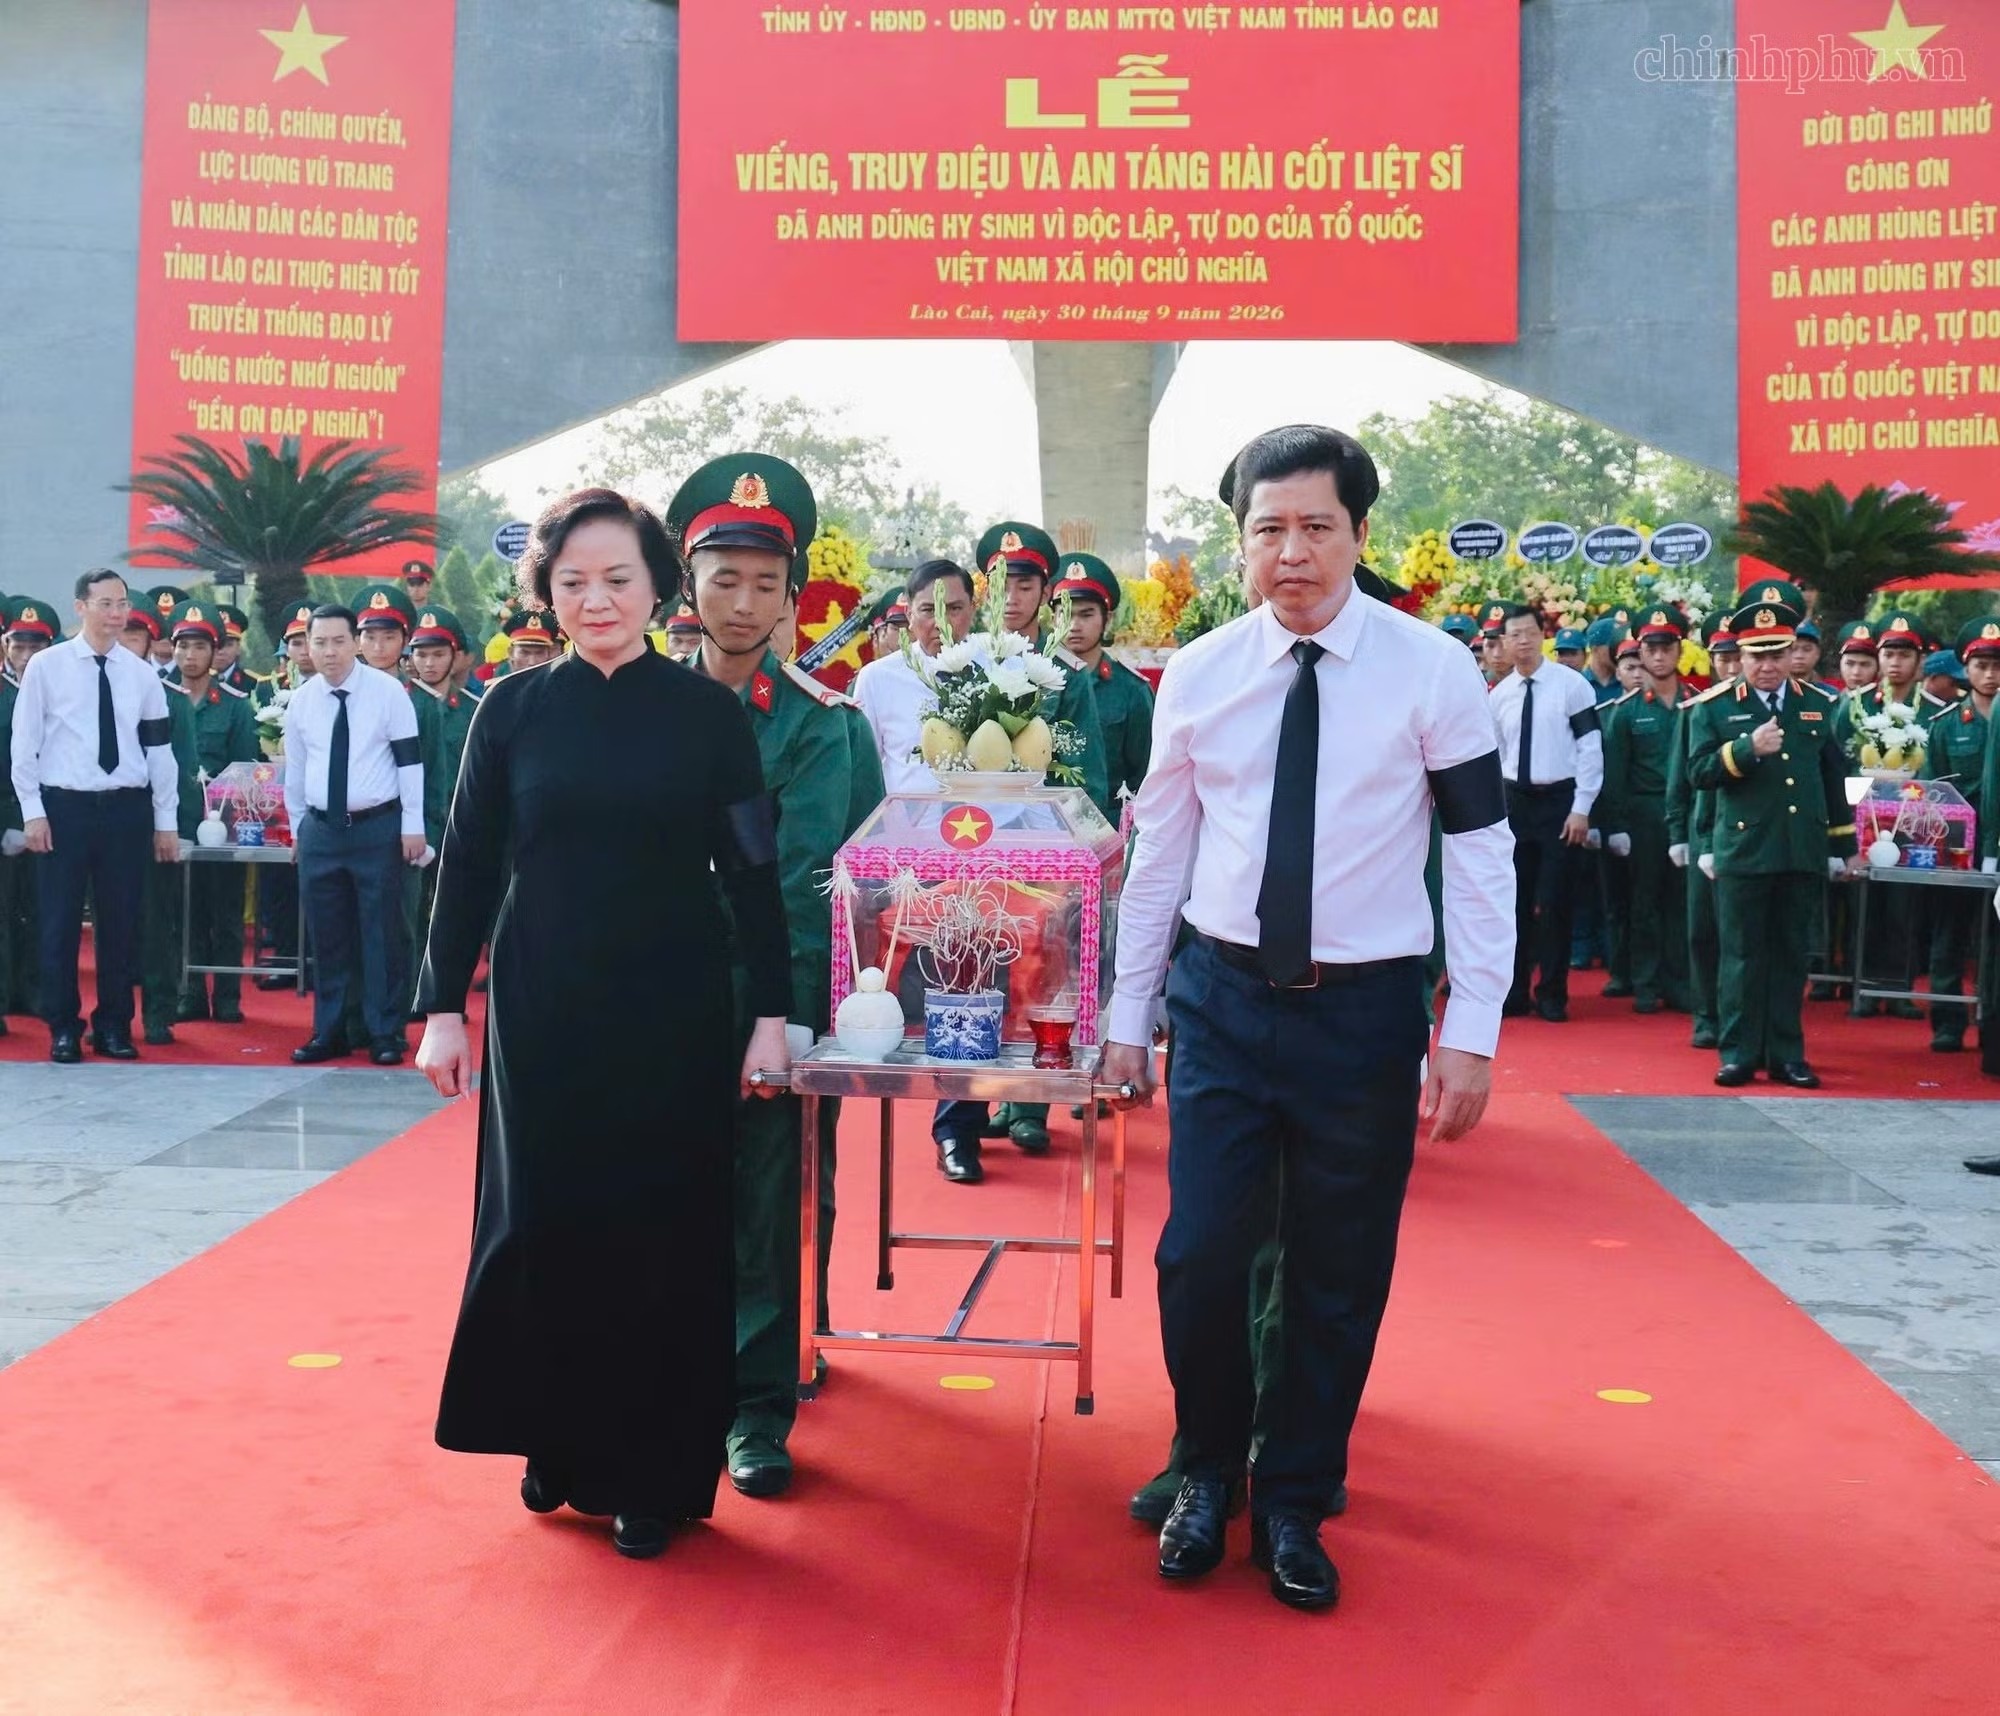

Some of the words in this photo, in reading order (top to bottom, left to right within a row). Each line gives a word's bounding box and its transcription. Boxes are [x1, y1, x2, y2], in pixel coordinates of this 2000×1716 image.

[761, 3, 811, 33] TỈNH
[818, 2, 848, 33] ỦY
[870, 9, 927, 32] HĐND
[949, 8, 1006, 31] UBND
[1029, 0, 1058, 31] ỦY
[1066, 8, 1109, 30] BAN
[1117, 7, 1175, 31] MTTQ
[1182, 2, 1231, 37] VIỆT
[1239, 7, 1286, 29] NAM
[1294, 0, 1344, 29] TỈNH
[1352, 1, 1394, 29] LÀO
[1402, 6, 1438, 29] CAI
[1005, 53, 1191, 129] LỄ
[188, 93, 239, 132] ĐẢNG
[244, 102, 274, 141] BỘ,
[280, 106, 337, 139] CHÍNH
[341, 108, 406, 148] QUYỀN,
[1803, 109, 1843, 146] ĐỜI
[1850, 107, 1888, 143] ĐỜI
[1896, 109, 1934, 140] GHI
[1941, 96, 1992, 136] NHỚ
[200, 150, 234, 184] LỰC
[240, 153, 300, 188] LƯỢNG
[306, 155, 329, 186] VŨ
[335, 162, 393, 191] TRANG
[735, 140, 838, 196] VIẾNG,
[847, 152, 928, 191] TRUY
[936, 143, 1010, 199] ĐIỆU
[1019, 143, 1061, 191] VÀ
[1070, 151, 1116, 191] AN
[1125, 142, 1210, 191] TÁNG
[1220, 143, 1274, 191] HÀI
[1284, 137, 1345, 191] CỐT
[1354, 143, 1421, 199] LIỆT
[1429, 143, 1464, 191] SĨ
[1846, 158, 1910, 193] CÔNG
[1917, 158, 1949, 188] ƠN
[172, 196, 194, 228] VÀ
[199, 198, 251, 231] NHÂN
[256, 202, 294, 234] DÂN
[299, 204, 336, 238] CÁC
[341, 208, 379, 241] DÂN
[384, 211, 418, 248] TỘC
[776, 208, 809, 240] ĐÃ
[815, 214, 863, 239] ANH
[871, 207, 935, 240] DŨNG
[942, 213, 973, 239] HY
[980, 213, 1035, 240] SINH
[1042, 207, 1065, 239] VÌ
[1072, 206, 1121, 245] ĐỘC
[1128, 206, 1180, 244] LẬP,
[1187, 208, 1221, 245] TỰ
[1226, 213, 1260, 240] DO
[1266, 204, 1313, 240] CỦA
[1320, 200, 1353, 240] TỔ
[1358, 204, 1423, 244] QUỐC
[1772, 213, 1817, 247] CÁC
[1824, 213, 1871, 244] ANH
[1878, 206, 1942, 241] HÙNG
[1949, 201, 1997, 241] LIỆT
[164, 243, 207, 280] TỈNH
[211, 250, 247, 284] LÀO
[252, 257, 282, 285] CAI
[288, 260, 334, 293] THỰC
[340, 260, 383, 297] HIỆN
[388, 259, 420, 294] TỐT
[936, 250, 989, 287] VIỆT
[996, 256, 1048, 282] NAM
[1055, 250, 1086, 282] XÃ
[1093, 250, 1134, 287] HỘI
[1140, 247, 1189, 283] CHỦ
[1197, 250, 1268, 283] NGHĨA
[1772, 270, 1802, 298] ĐÃ
[1808, 266, 1856, 297] ANH
[1863, 260, 1926, 293] DŨNG
[1934, 261, 1963, 289] HY
[189, 298, 259, 334] TRUYỀN
[264, 302, 324, 338] THỐNG
[329, 313, 366, 345] ĐẠO
[371, 311, 392, 342] LÝ
[910, 304, 948, 319] Lào
[955, 304, 994, 322] Cai,
[1002, 306, 1050, 323] ngày
[1057, 305, 1086, 319] 30
[1092, 304, 1149, 322] tháng
[1156, 305, 1170, 320] 9
[1177, 306, 1220, 320] năm
[1228, 304, 1284, 320] 2026
[1796, 315, 1817, 347] VÌ
[1824, 311, 1870, 351] ĐỘC
[1877, 309, 1928, 349] LẬP,
[1935, 308, 1967, 346] TỰ
[1972, 310, 2000, 339] DO
[171, 344, 230, 383] “UỐNG
[235, 352, 285, 385] NƯỚC
[291, 354, 330, 388] NHỚ
[1767, 362, 1812, 402] CỦA
[1819, 360, 1847, 400] TỔ
[1853, 359, 1915, 401] QUỐC
[1922, 360, 1972, 400] VIỆT
[1979, 364, 2000, 392] N
[240, 405, 265, 432] ƠN
[270, 403, 308, 435] ĐÁP
[1791, 420, 1820, 452] XÃ
[1827, 418, 1866, 456] HỘI
[1872, 408, 1919, 450] CHỦ
[1926, 412, 2000, 448] NGHĨA
